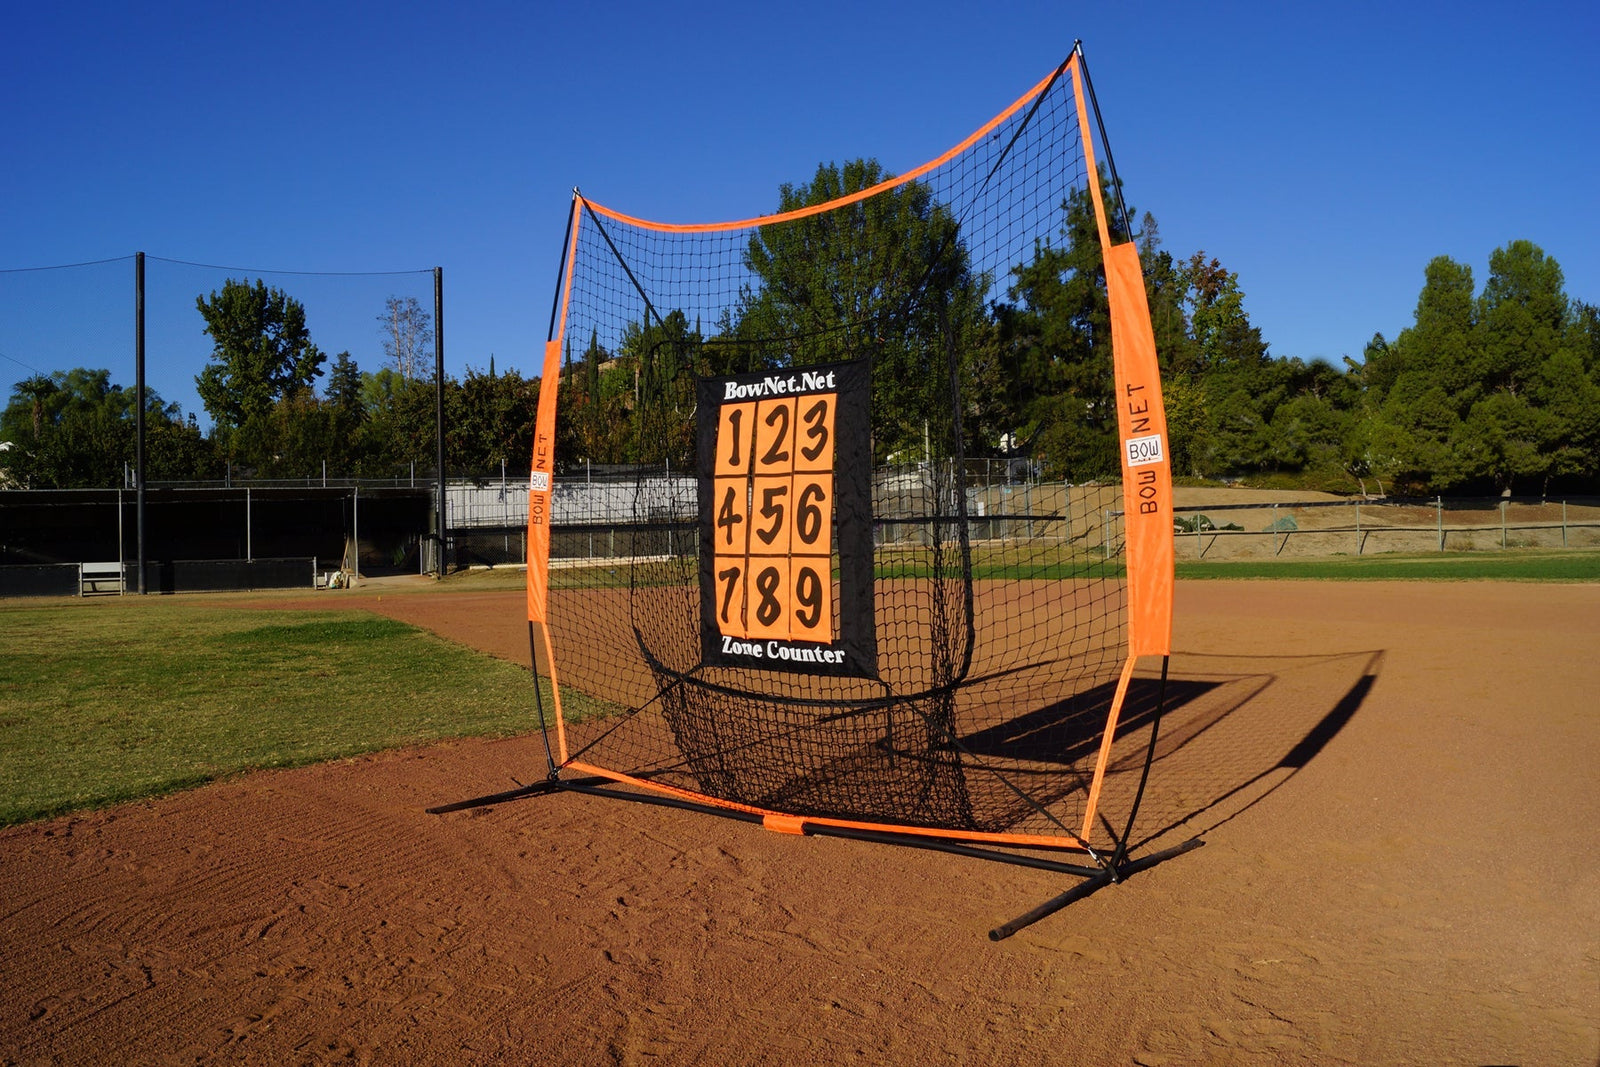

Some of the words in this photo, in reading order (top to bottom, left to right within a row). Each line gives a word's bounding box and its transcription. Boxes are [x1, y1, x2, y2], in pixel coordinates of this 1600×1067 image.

[723, 370, 836, 400] BowNet.Net
[1126, 384, 1151, 433] NET
[728, 408, 743, 467] 1
[760, 404, 789, 466] 2
[800, 399, 828, 462] 3
[1129, 440, 1159, 460] BOW
[536, 434, 547, 469] NET
[532, 474, 548, 487] BOW
[1137, 470, 1158, 515] BOW
[533, 495, 544, 525] BOW
[717, 486, 743, 546] 4
[756, 485, 788, 546] 5
[796, 483, 826, 545] 6
[718, 566, 741, 624] 7
[756, 565, 782, 627] 8
[795, 566, 823, 629] 9
[721, 635, 763, 659] Zone
[766, 640, 846, 664] Counter
